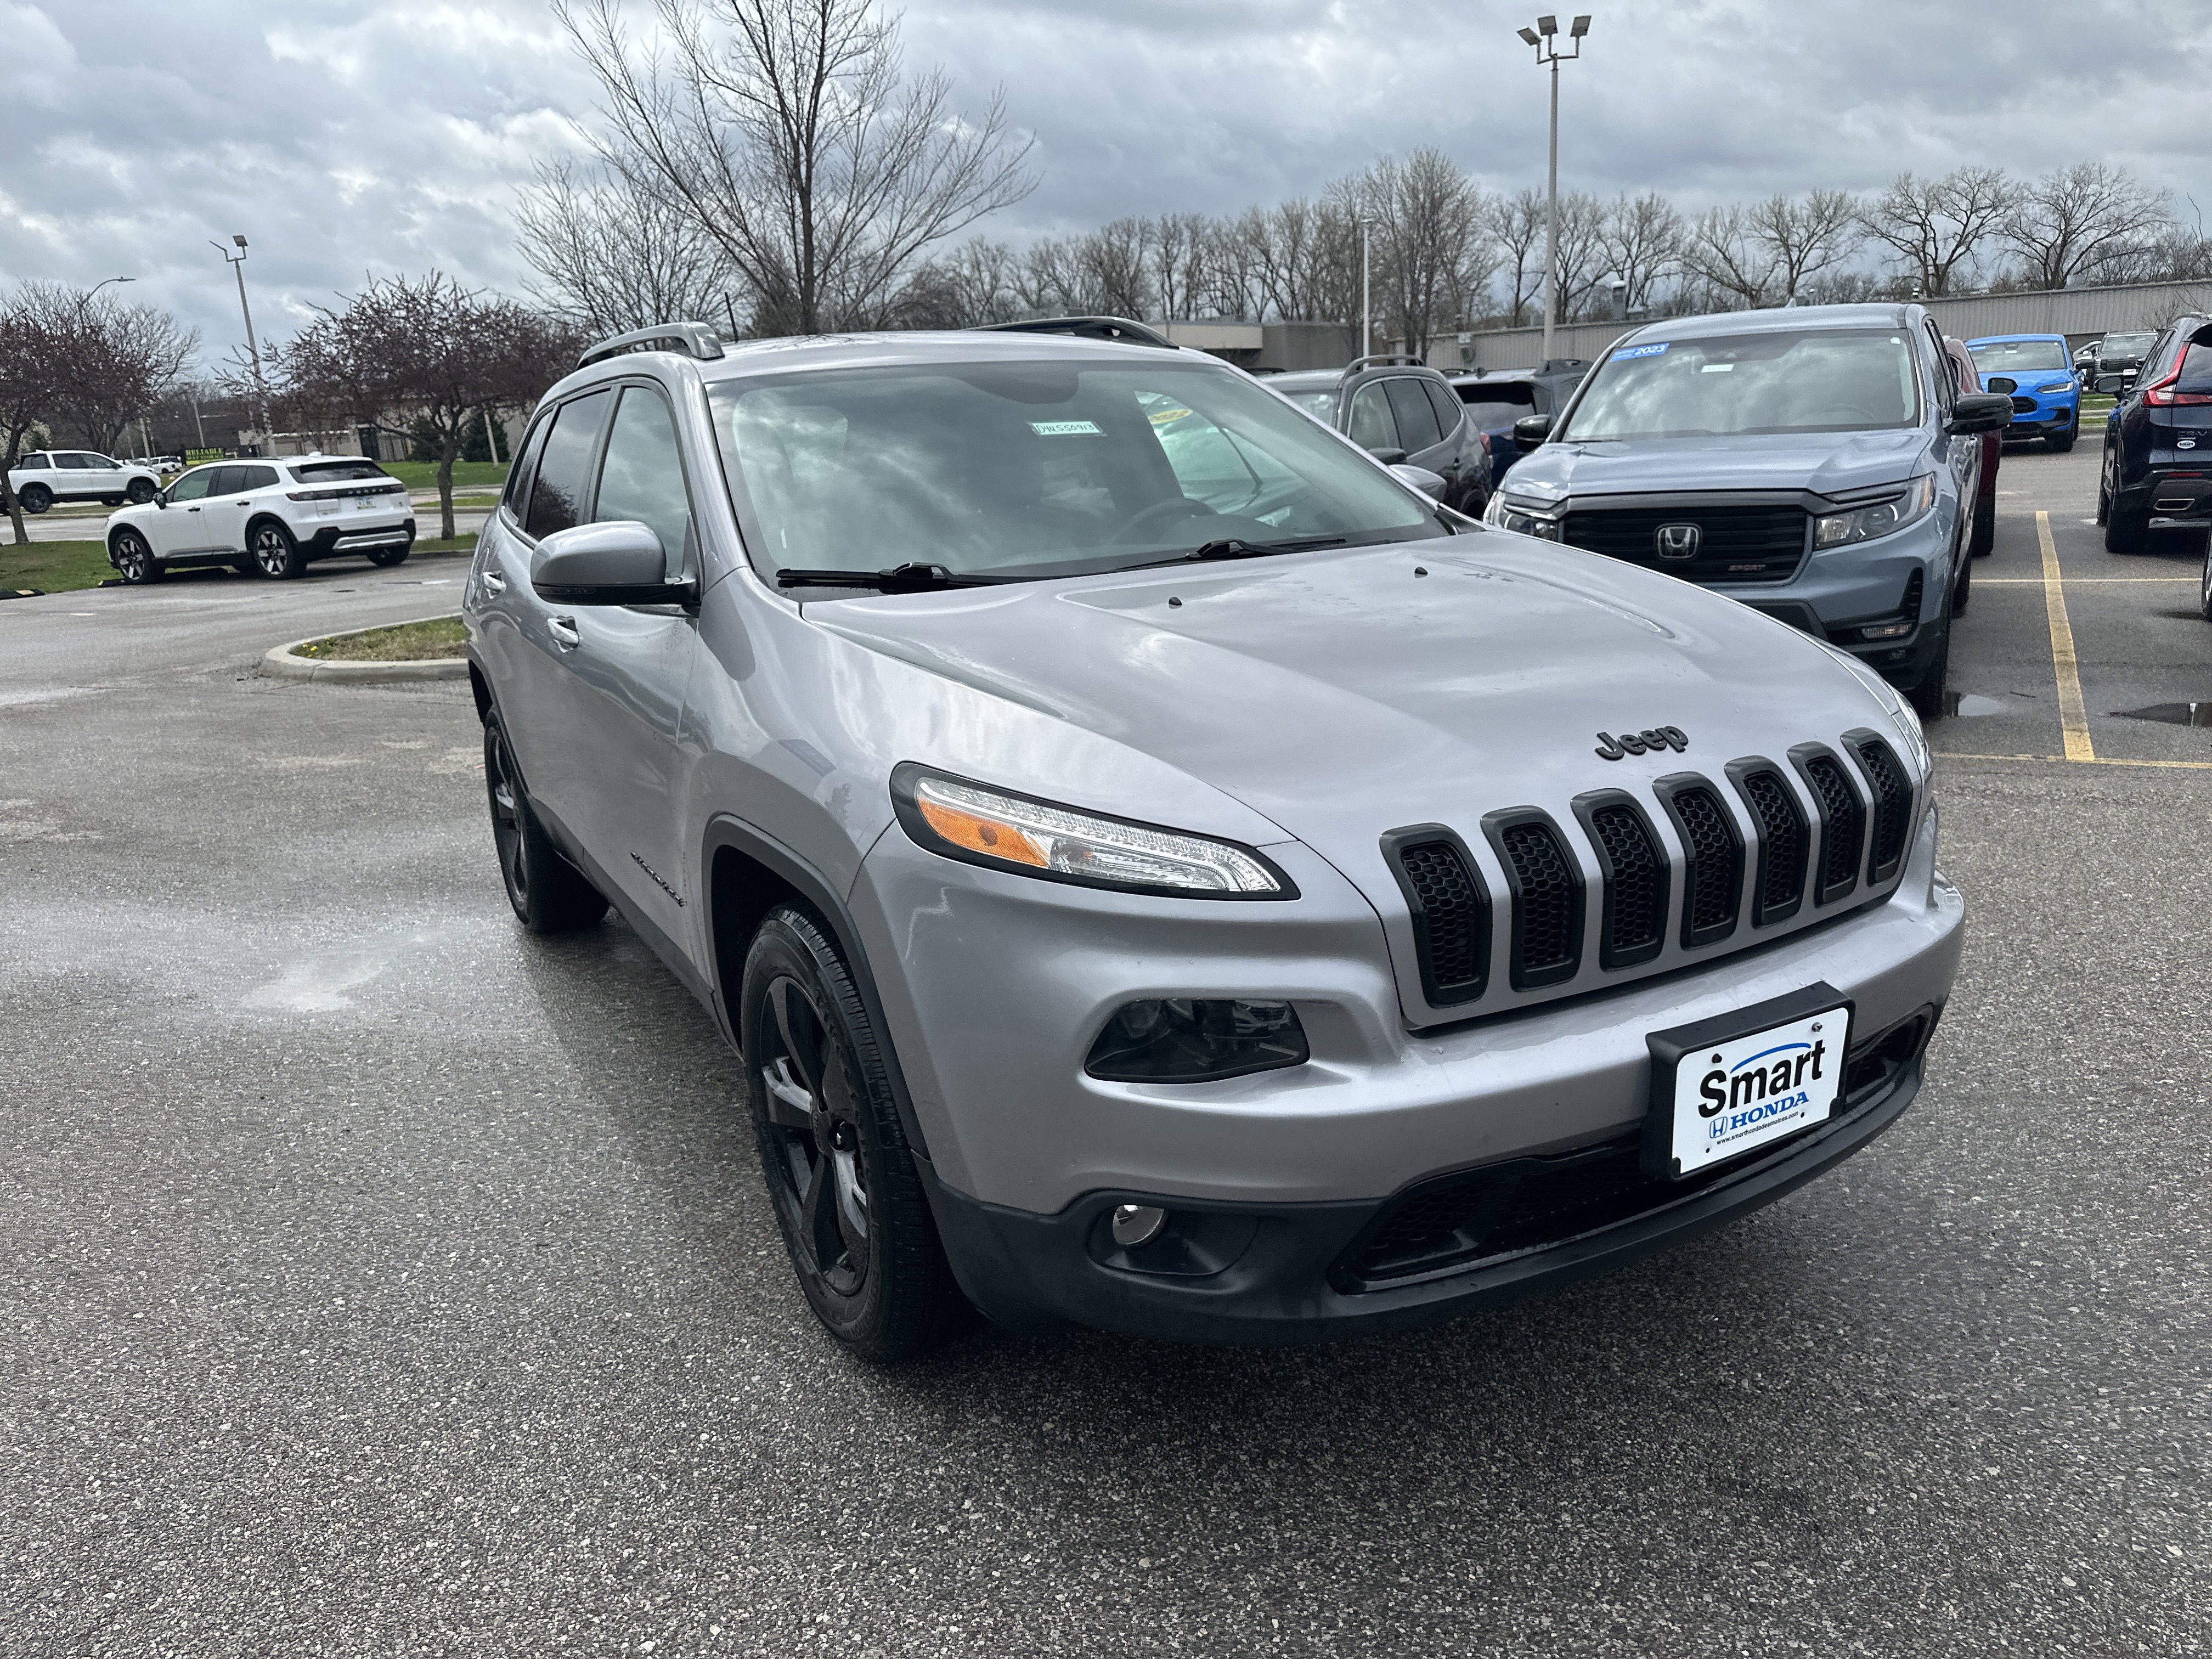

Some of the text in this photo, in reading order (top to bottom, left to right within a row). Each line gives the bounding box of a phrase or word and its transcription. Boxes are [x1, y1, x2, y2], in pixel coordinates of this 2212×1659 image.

[1634, 345, 1666, 355] 2023
[1595, 726, 1689, 761] Jeep
[1698, 1039, 1826, 1118] Smart
[1730, 1091, 1809, 1130] HONDA
